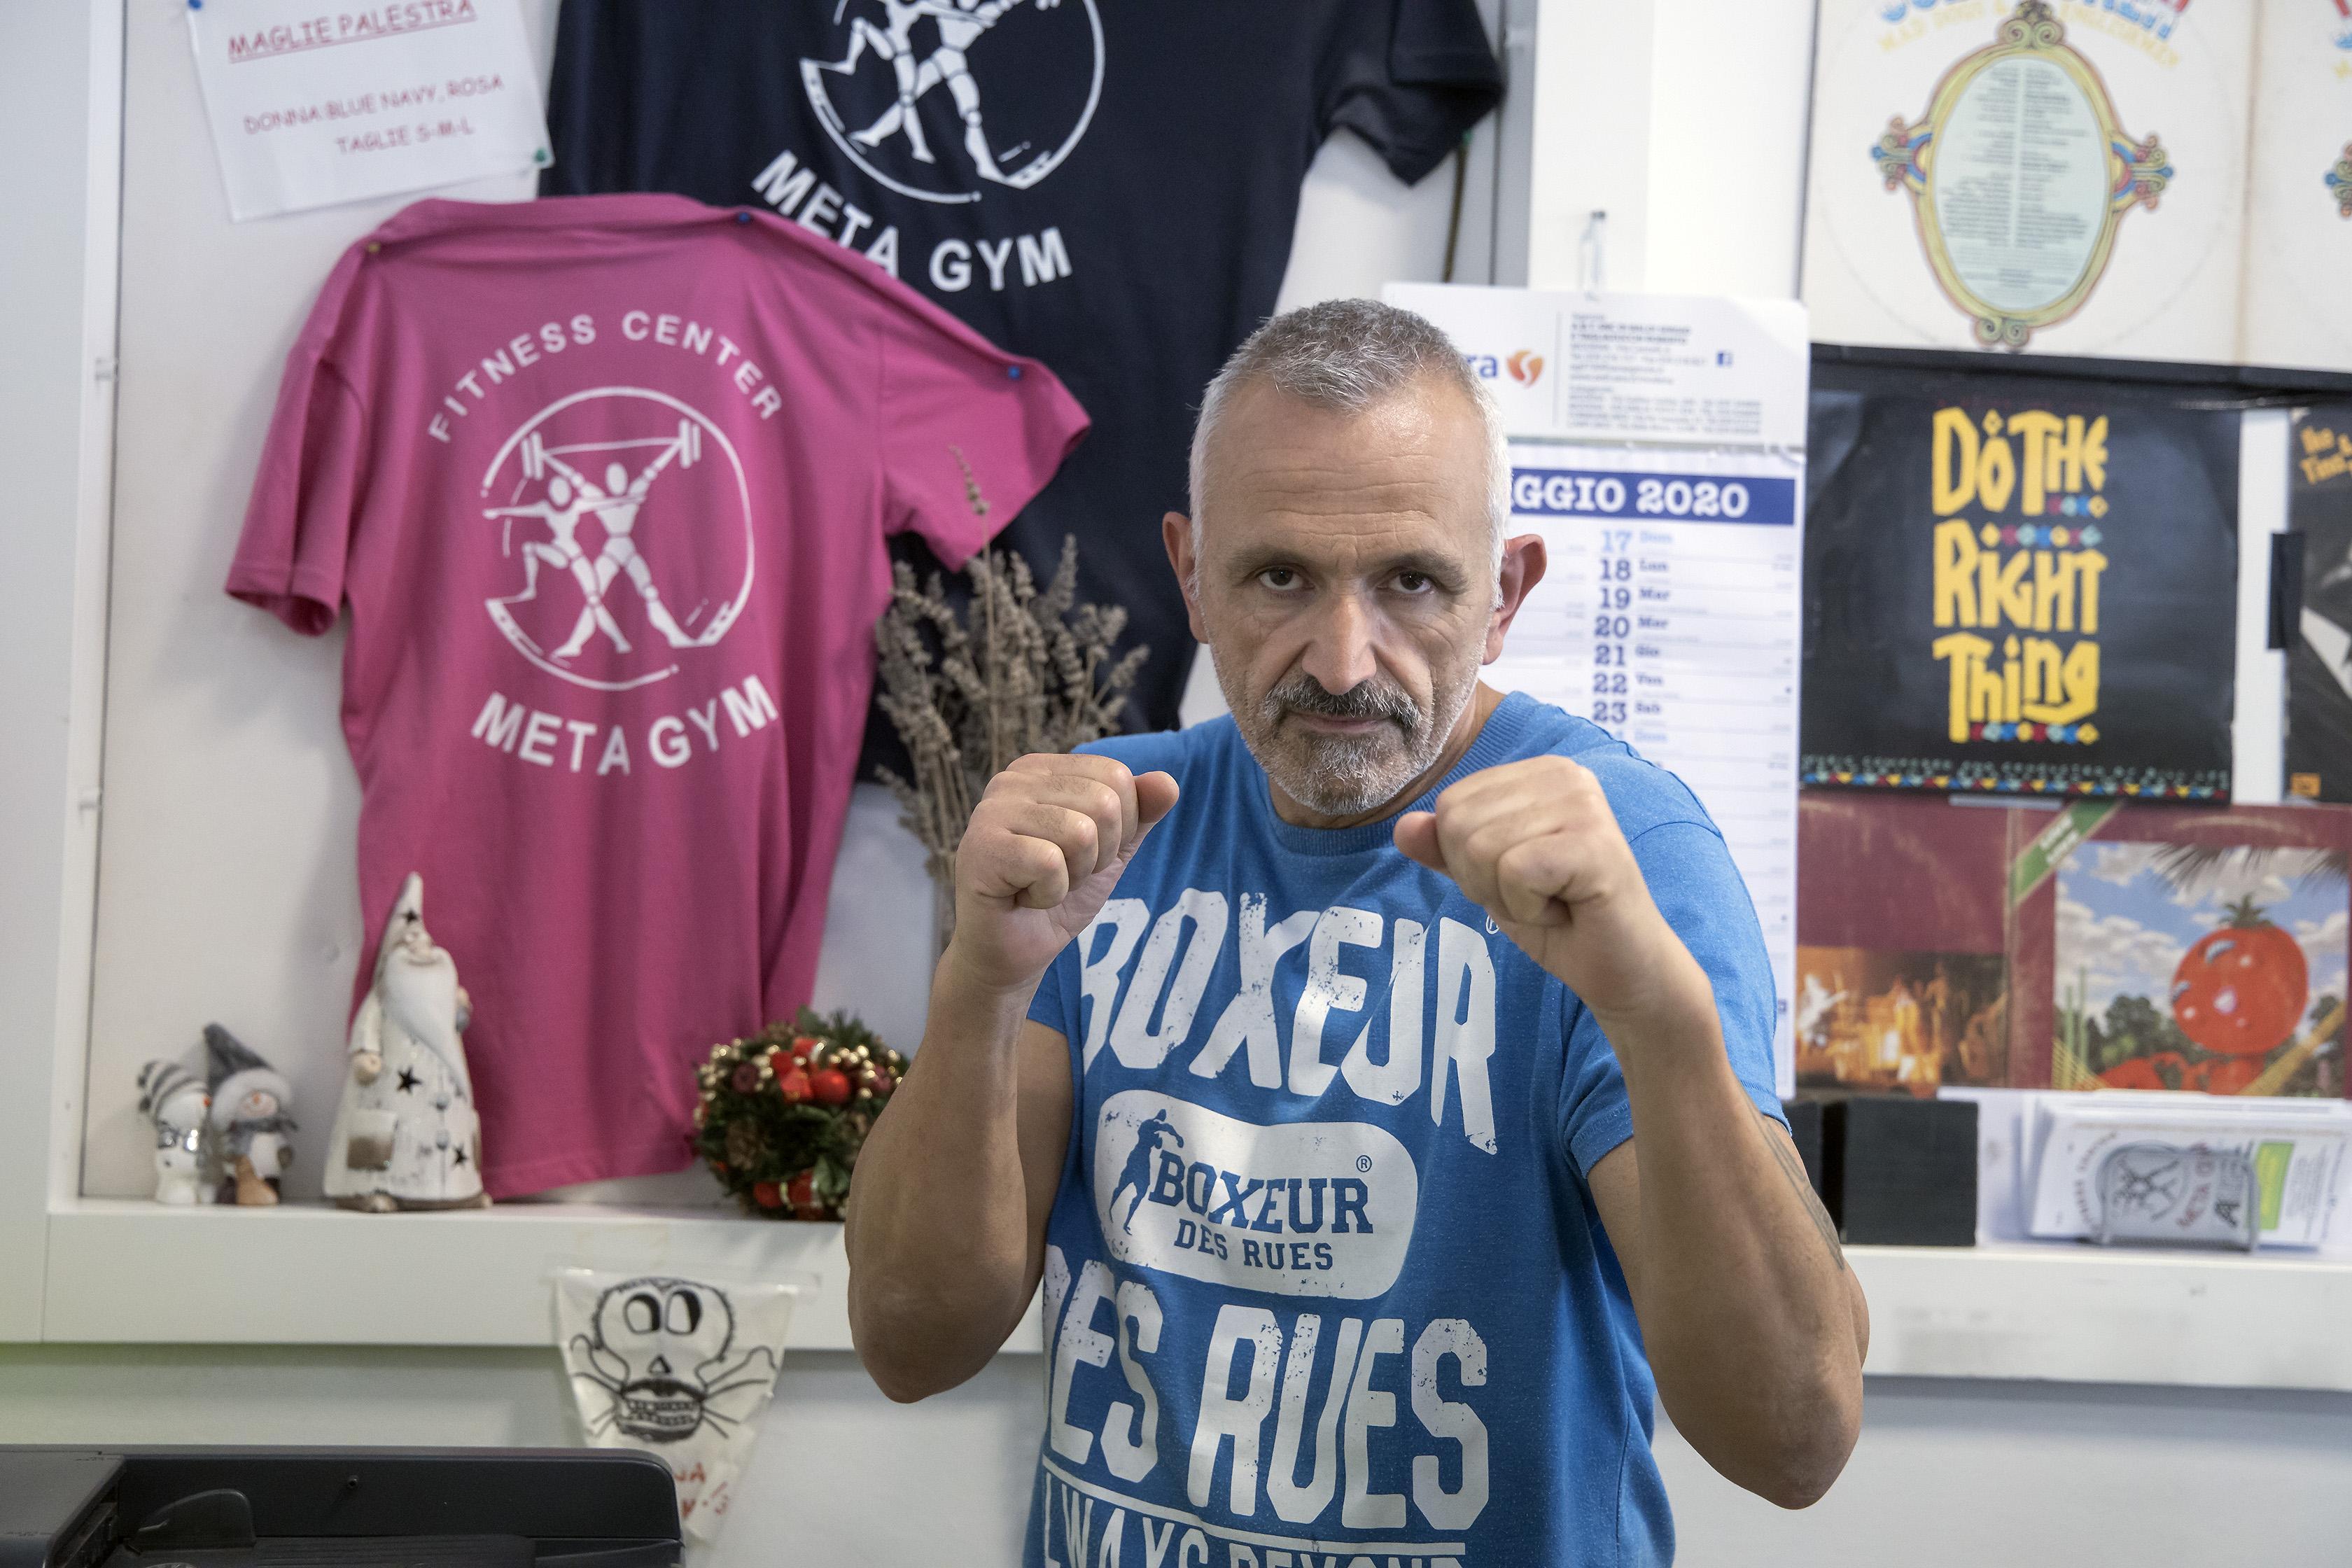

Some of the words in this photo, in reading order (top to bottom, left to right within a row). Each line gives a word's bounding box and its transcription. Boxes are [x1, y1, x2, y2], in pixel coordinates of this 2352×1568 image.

[227, 15, 332, 58] MAGLIE
[339, 0, 477, 37] PALESTRA
[244, 102, 321, 134] DONNA
[326, 93, 375, 119] BLUE
[447, 74, 503, 98] ROSA
[335, 126, 411, 155] TAGLIE
[751, 149, 900, 279] META
[928, 225, 1073, 292] GYM
[428, 314, 597, 442] FITNESS
[621, 310, 782, 420] CENTER
[1511, 474, 1627, 512] GGIO
[1635, 478, 1750, 519] 2020
[1601, 530, 1632, 554] 17
[1599, 559, 1631, 582] 18
[1598, 587, 1631, 610] 19
[1594, 615, 1630, 639] 20
[1594, 643, 1628, 667] 21
[1592, 672, 1628, 695] 22
[471, 691, 631, 776] META
[648, 673, 778, 769] GYM
[1592, 701, 1627, 724] 23
[1077, 887, 1498, 1156] BOXEUR
[1148, 1149, 1373, 1234] BOXEUR
[1173, 1219, 1228, 1261] DES
[1242, 1238, 1334, 1270] RUES
[1187, 1304, 1490, 1530] RUES
